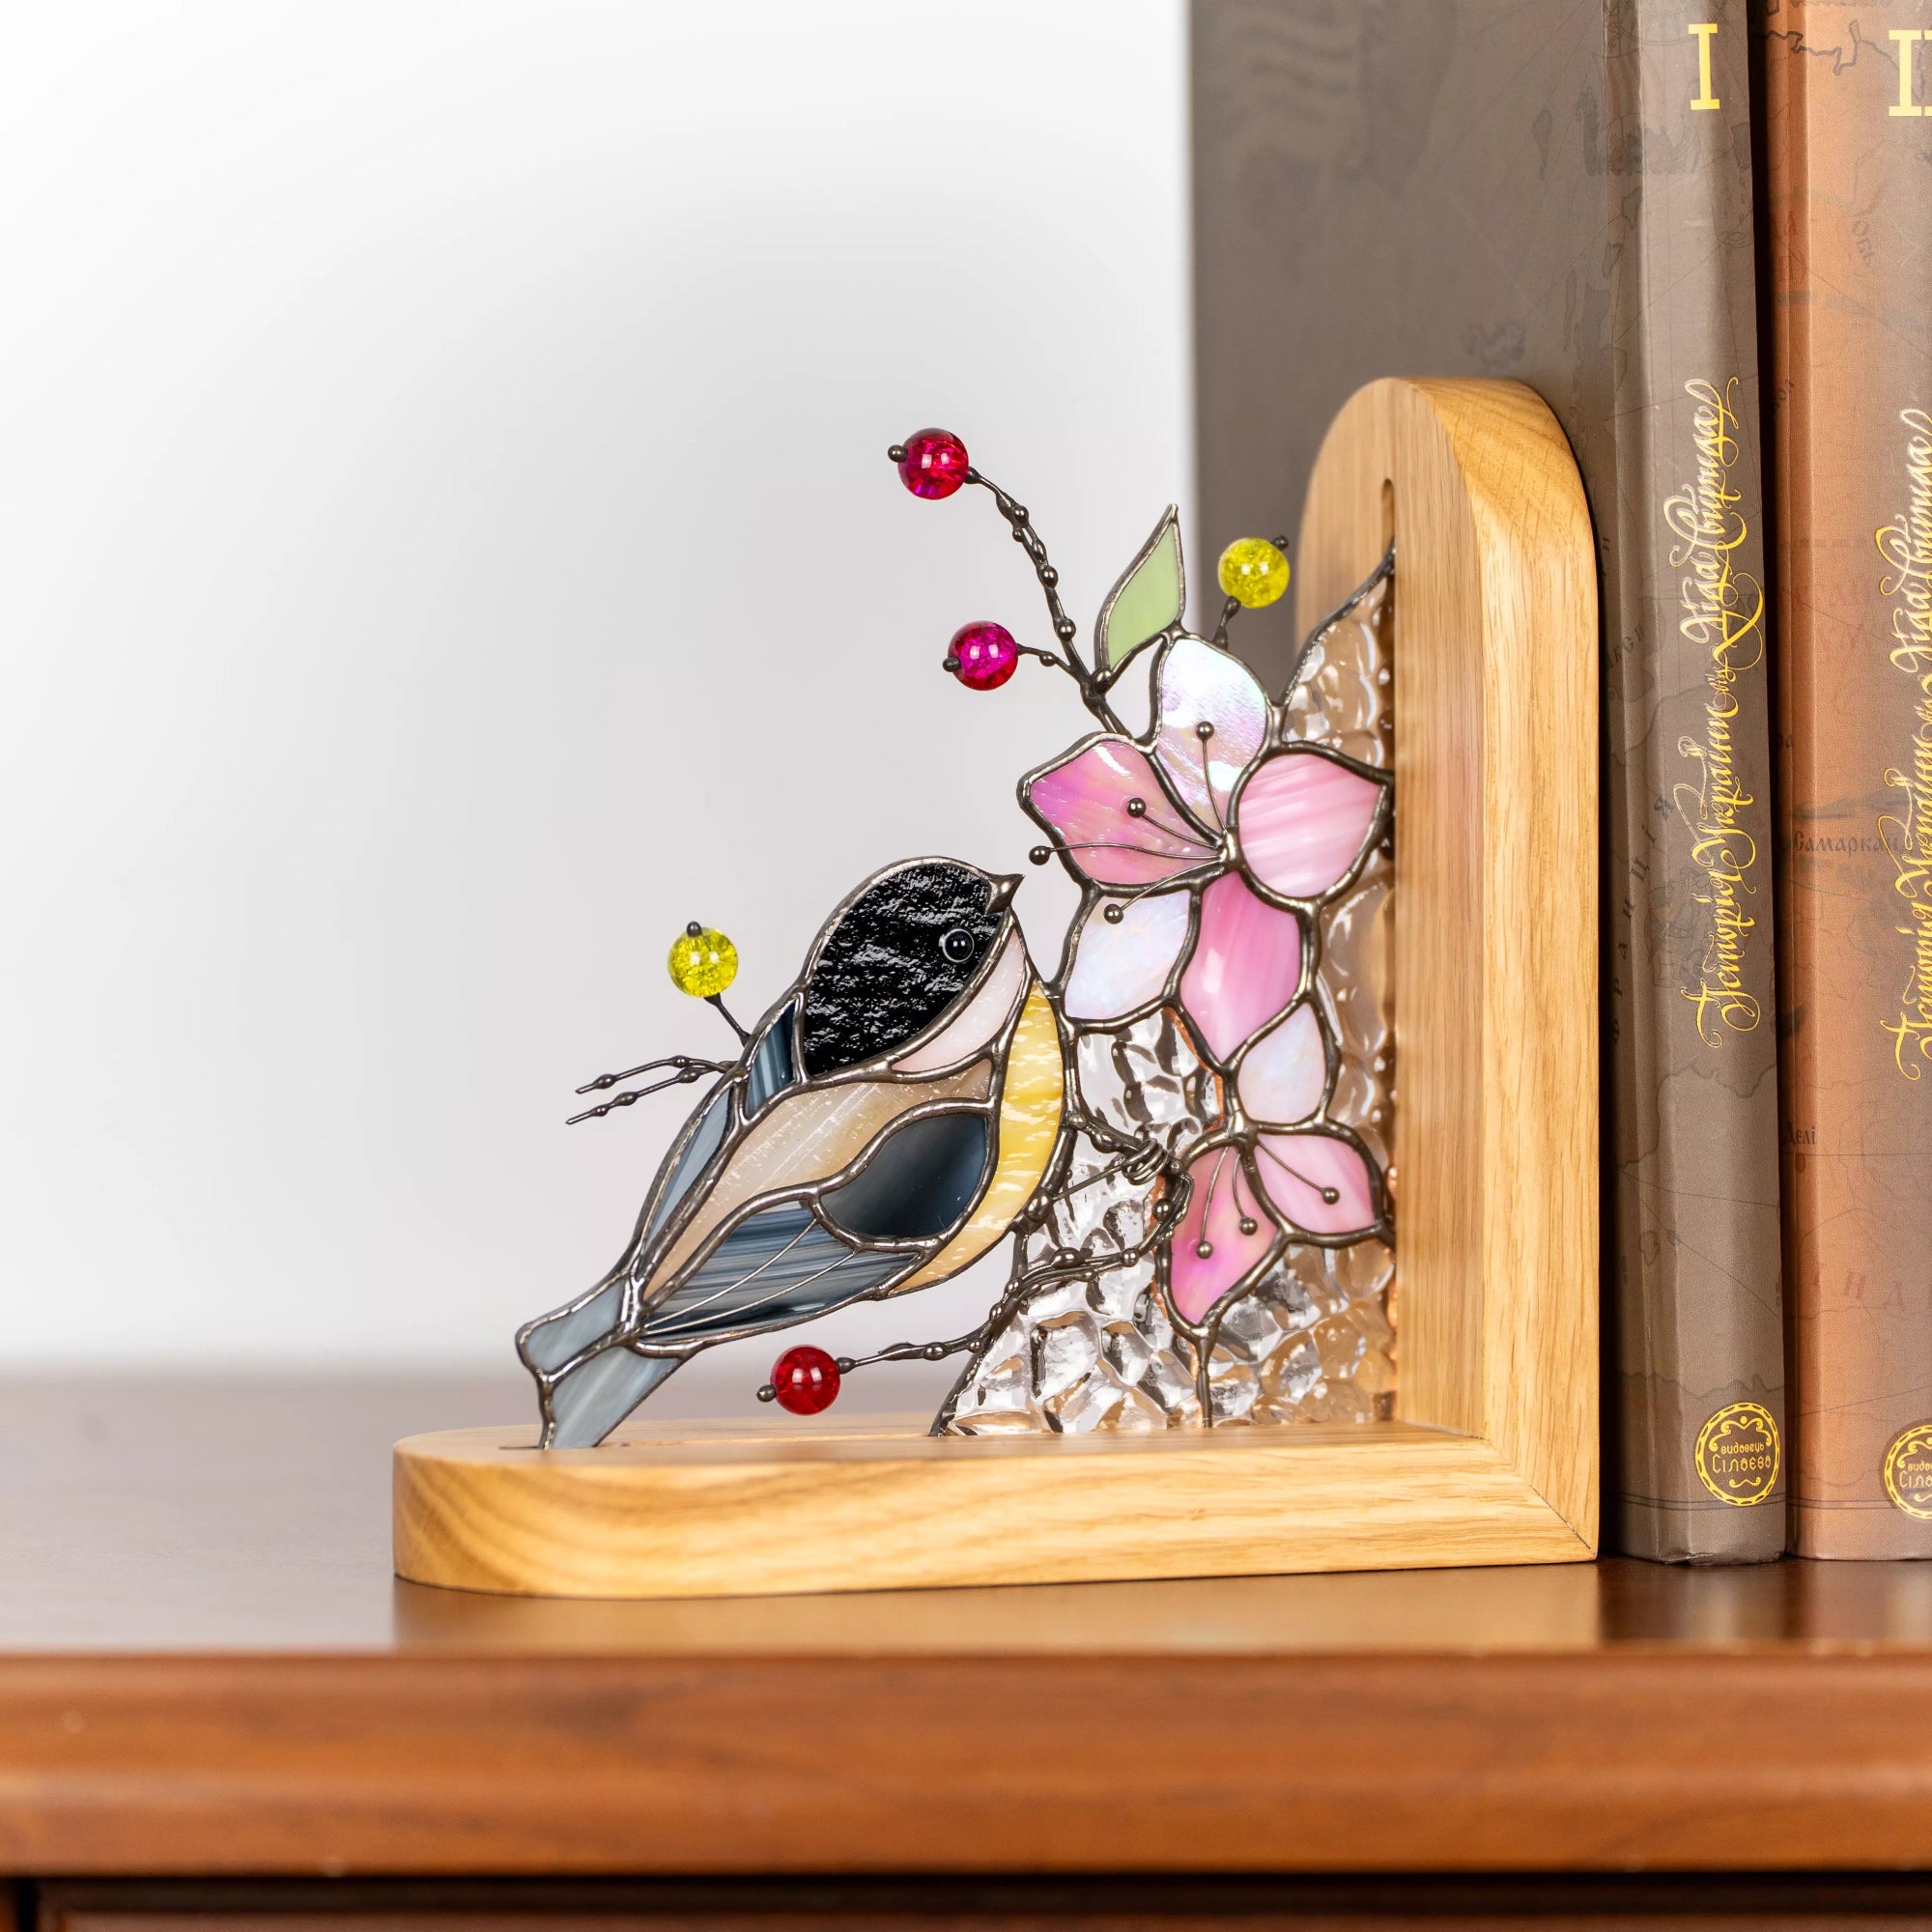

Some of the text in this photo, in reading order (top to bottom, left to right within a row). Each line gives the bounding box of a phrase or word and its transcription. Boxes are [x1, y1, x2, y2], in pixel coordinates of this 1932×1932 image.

[1688, 23, 1720, 110] I
[1663, 377, 1748, 576] Свирида
[1680, 542, 1764, 670] Діда
[1673, 693, 1756, 894] України
[1680, 869, 1761, 1048] Історія
